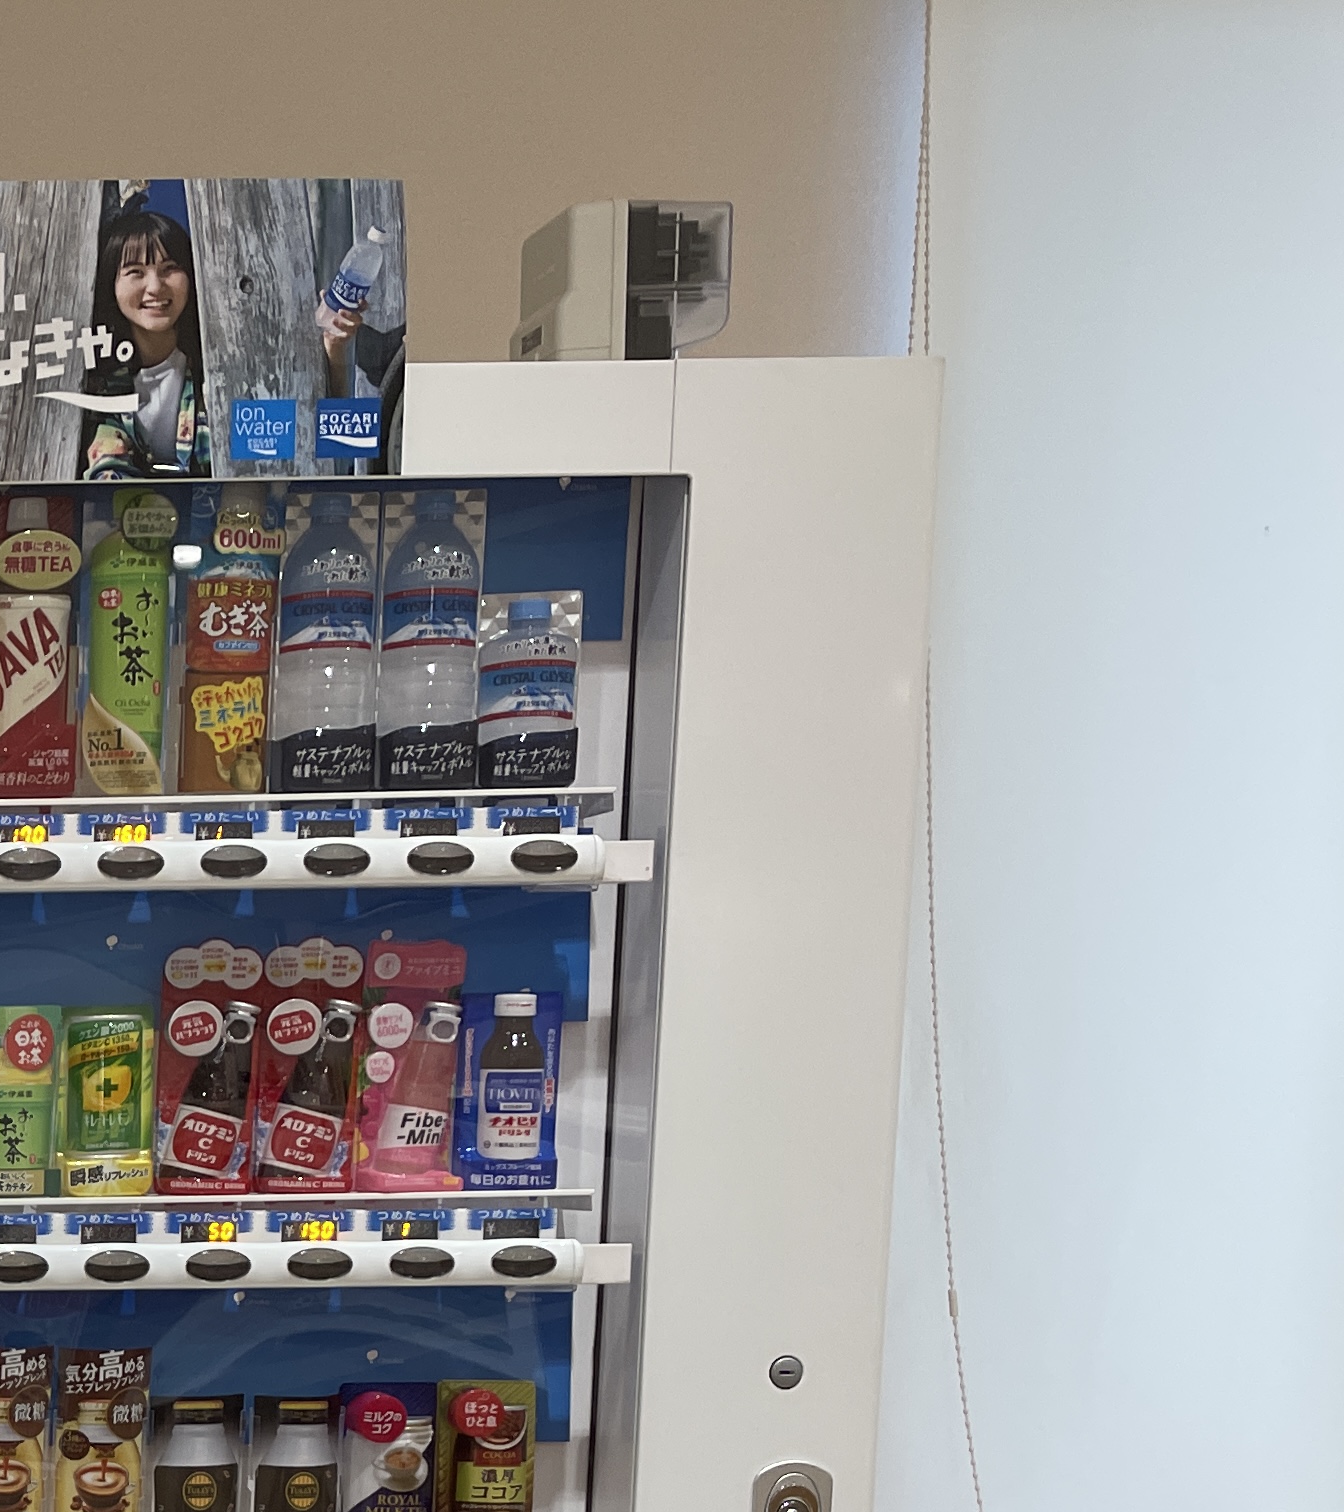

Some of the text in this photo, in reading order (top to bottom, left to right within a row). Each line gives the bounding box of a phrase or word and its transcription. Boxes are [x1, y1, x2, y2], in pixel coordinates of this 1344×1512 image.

[237, 403, 264, 422] ion
[320, 413, 377, 424] POCARI
[235, 421, 292, 435] water
[320, 424, 371, 434] SWEAT
[219, 529, 281, 549] 600ml
[5, 556, 72, 573] 無糖TEA
[200, 600, 268, 638] むぎ茶
[112, 612, 153, 686] お茶
[183, 1118, 234, 1142] オロナミン
[281, 1117, 333, 1140] オロナミン
[198, 1138, 213, 1149] C
[186, 1149, 216, 1164] ドリンク
[364, 1411, 401, 1422] ミルクの
[372, 1423, 392, 1434] コク
[378, 1495, 421, 1506] ROYAL
[472, 1485, 522, 1501] ココア
